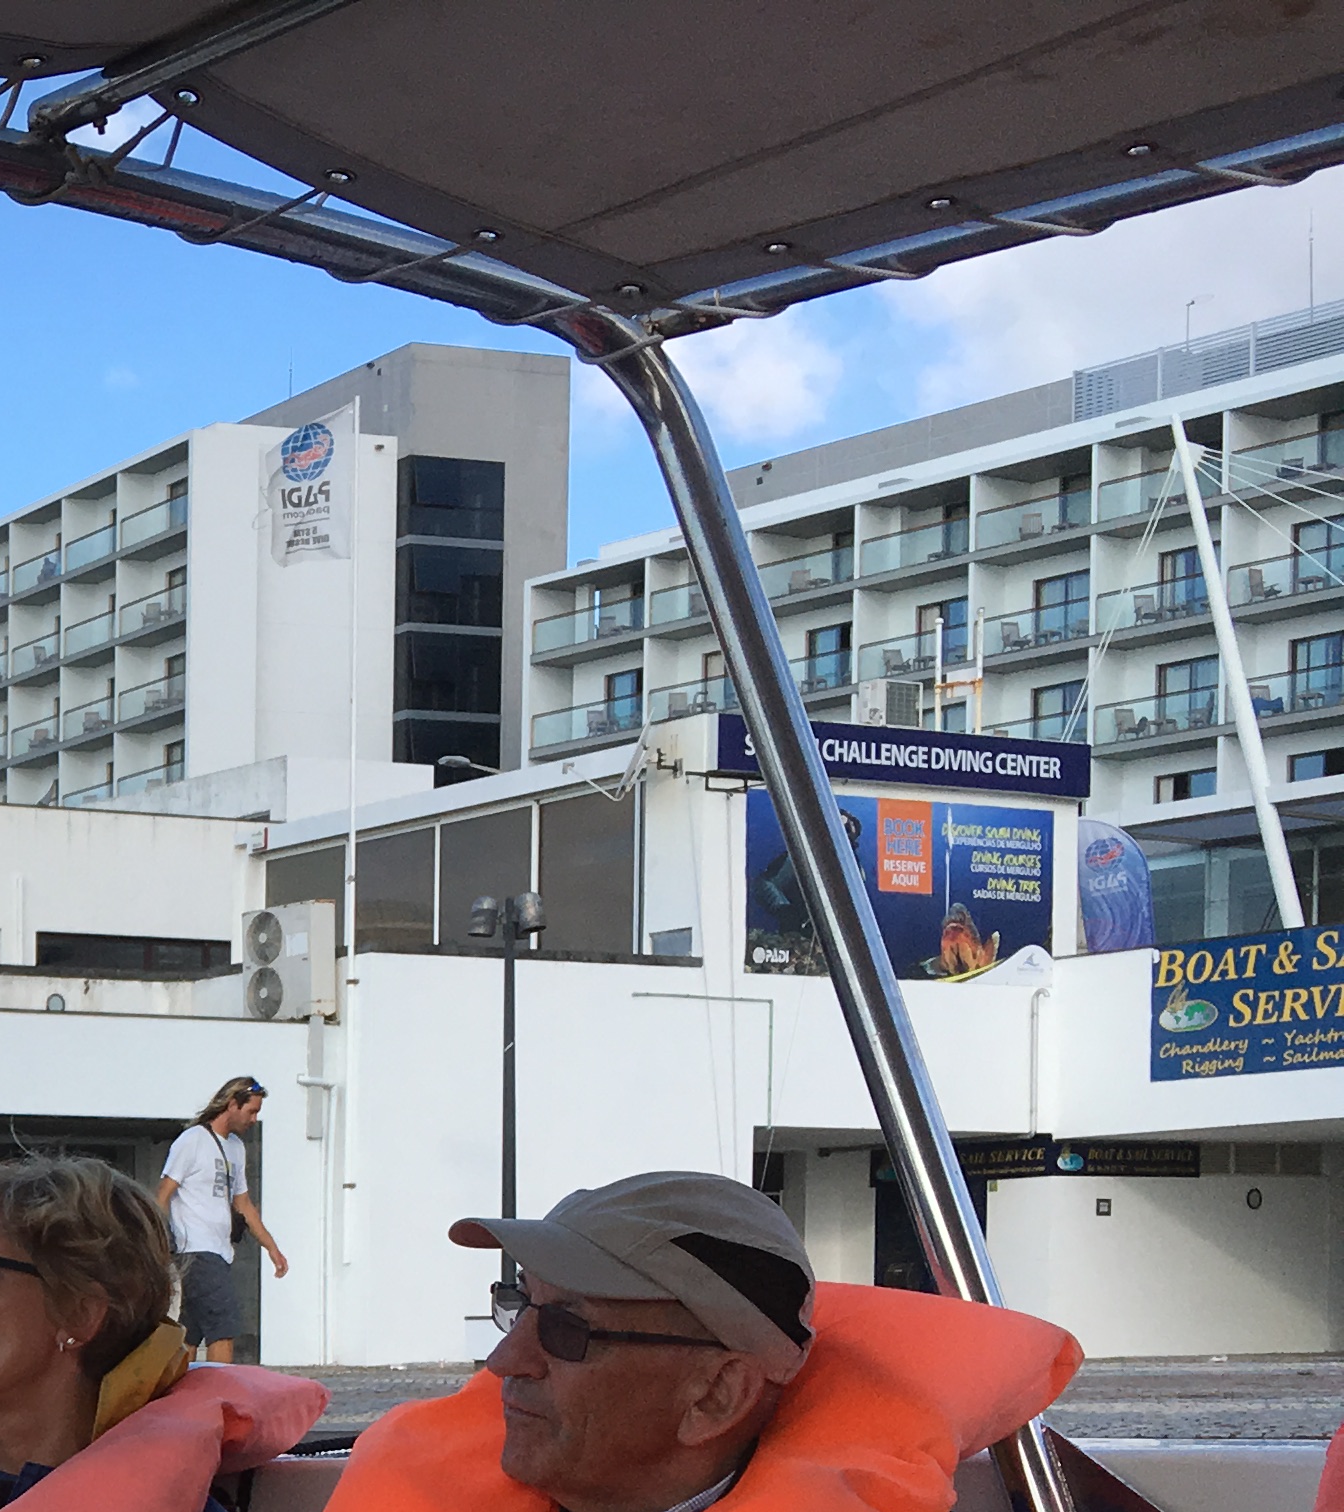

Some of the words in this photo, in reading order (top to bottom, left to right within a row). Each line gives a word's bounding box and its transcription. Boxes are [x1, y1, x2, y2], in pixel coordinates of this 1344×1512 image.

[823, 740, 929, 769] CHALLENGE
[931, 747, 993, 774] DIVING
[995, 752, 1061, 779] CENTER
[883, 818, 925, 838] BOOK
[885, 837, 923, 857] HERE
[883, 859, 927, 874] RESERVE
[891, 873, 919, 886] AQUI!
[765, 949, 790, 964] PADI
[1154, 944, 1267, 988] BOAT
[1272, 940, 1302, 975] &
[1159, 1037, 1249, 1059] Chandlery
[1182, 1056, 1244, 1076] Rigging
[990, 1147, 1046, 1163] SERVICE
